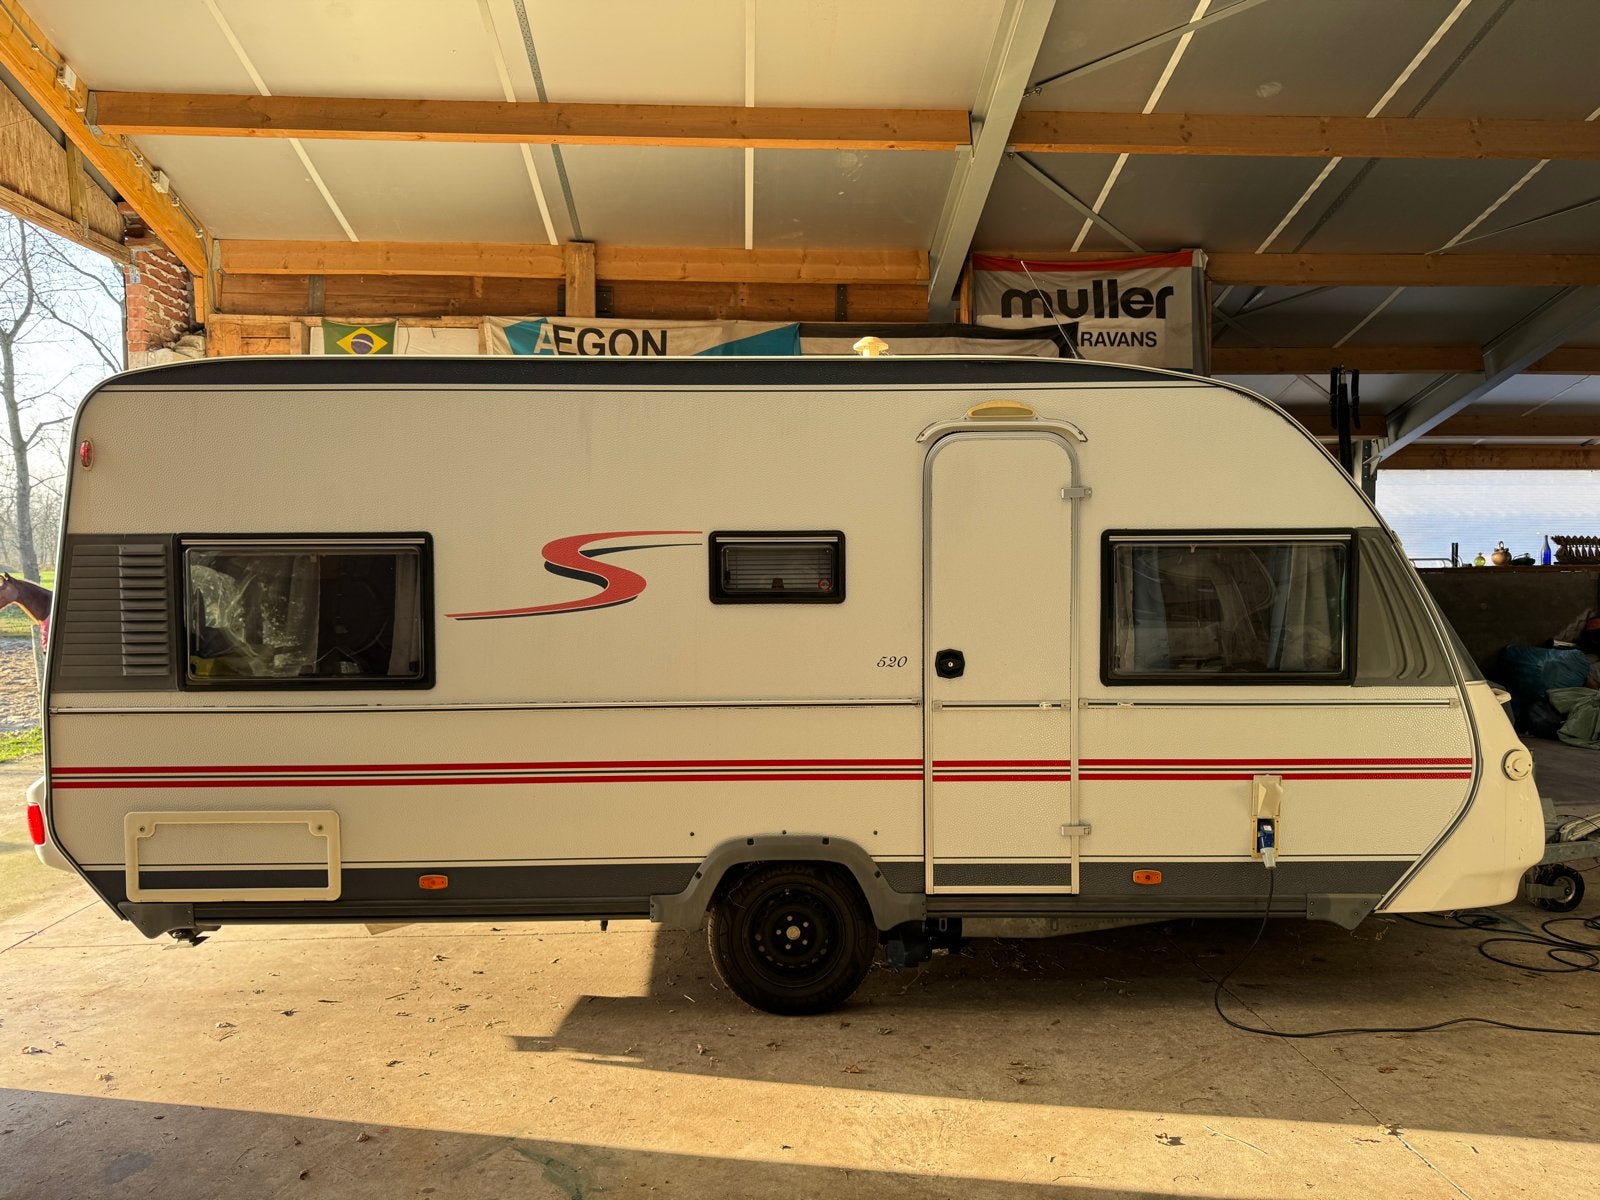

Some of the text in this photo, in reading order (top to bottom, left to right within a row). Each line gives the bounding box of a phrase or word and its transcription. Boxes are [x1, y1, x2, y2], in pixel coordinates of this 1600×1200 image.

[1001, 279, 1174, 319] muller
[533, 323, 668, 356] AEGON
[1077, 331, 1157, 348] RAVANS
[876, 655, 908, 668] 520
